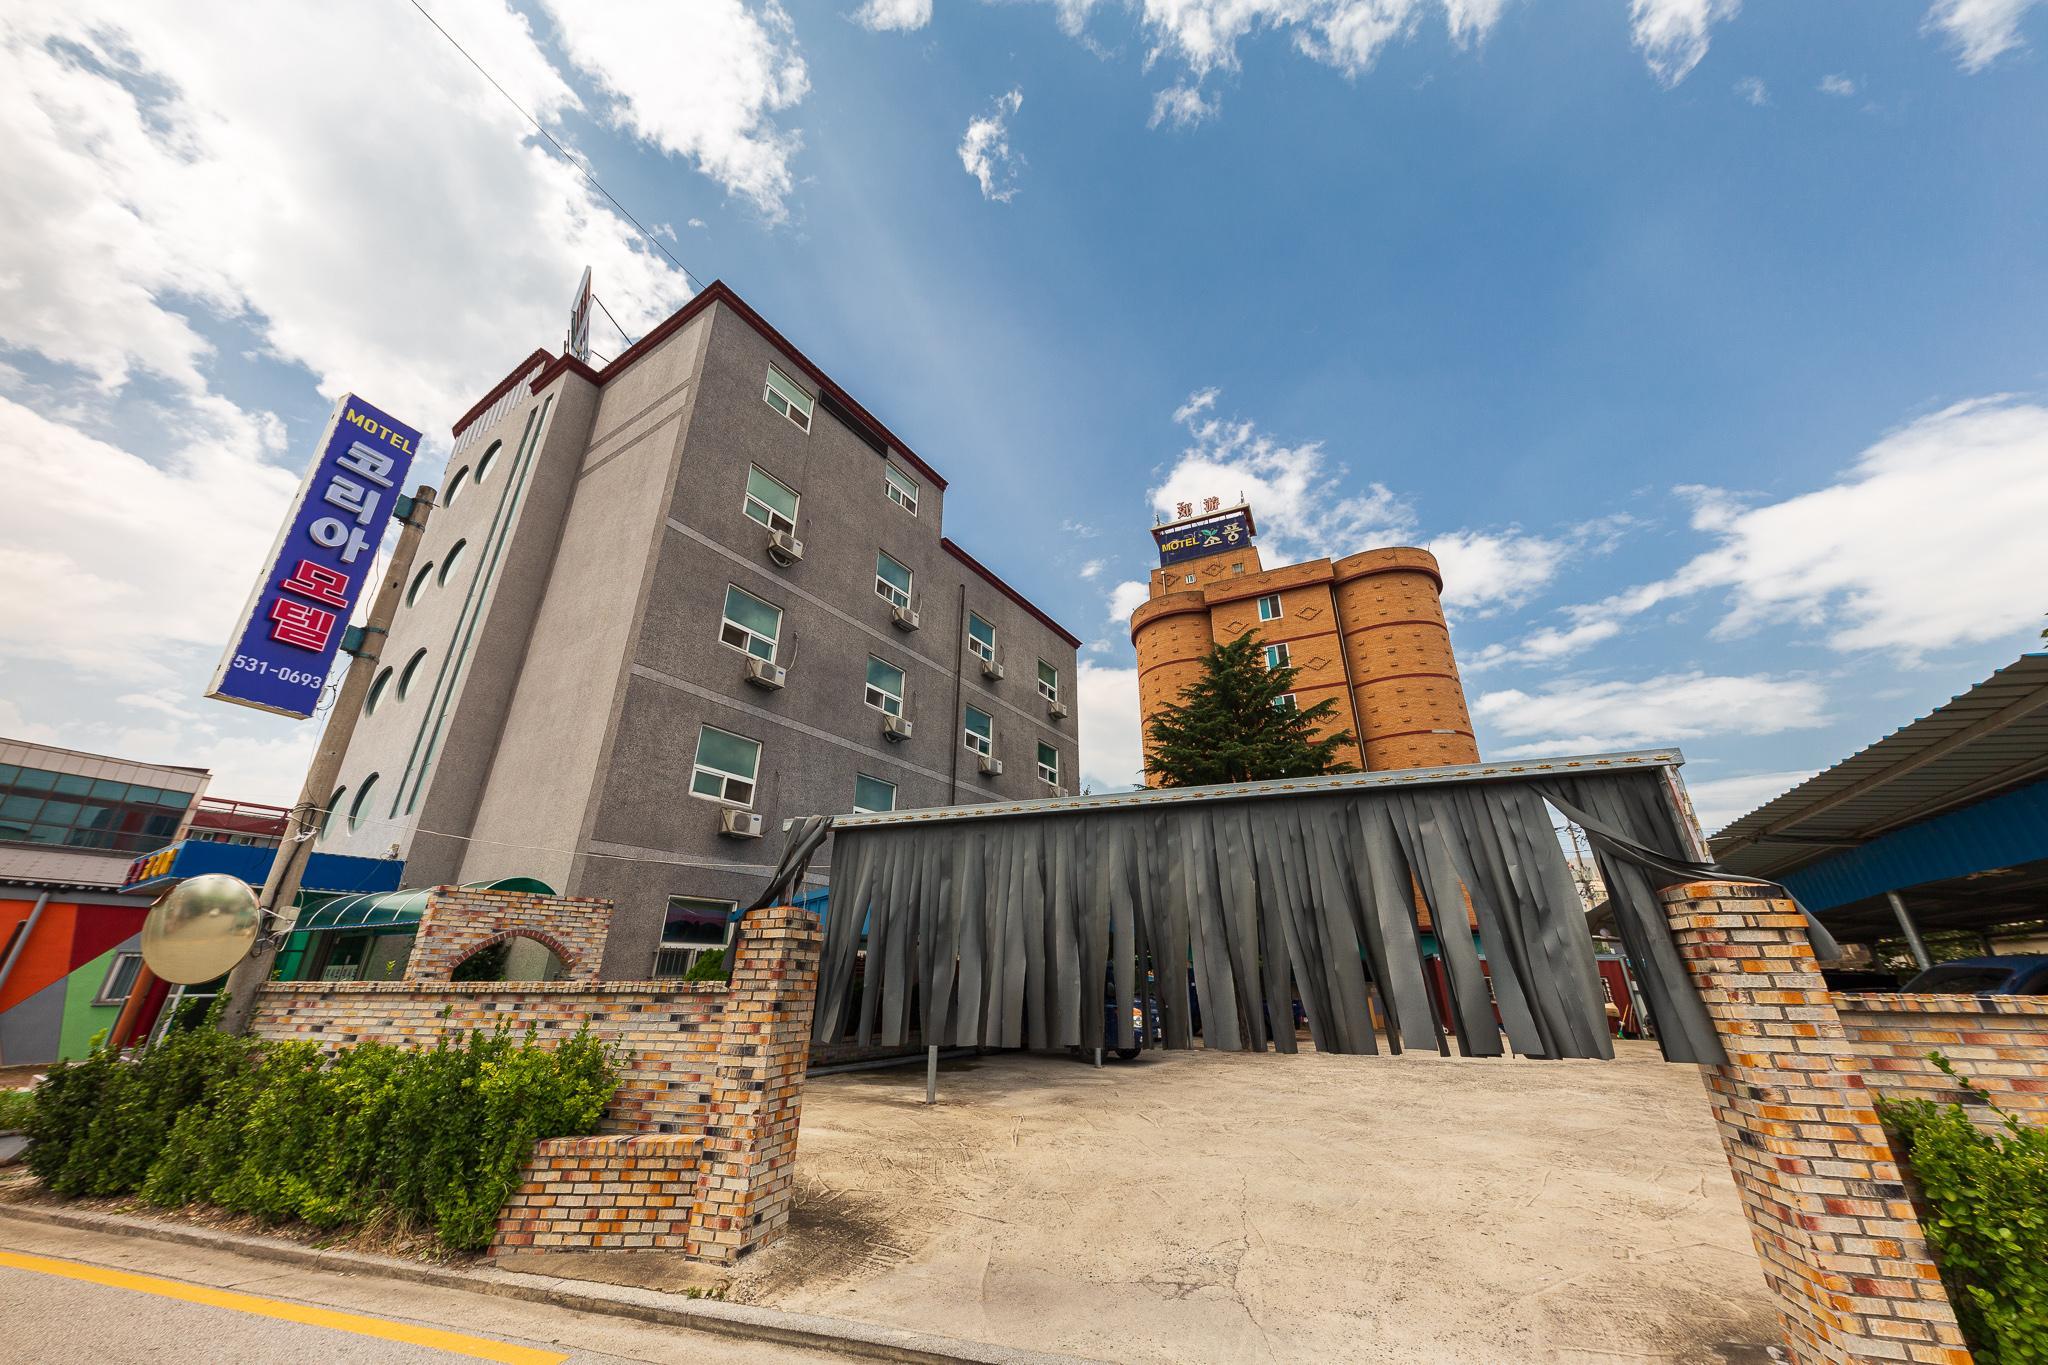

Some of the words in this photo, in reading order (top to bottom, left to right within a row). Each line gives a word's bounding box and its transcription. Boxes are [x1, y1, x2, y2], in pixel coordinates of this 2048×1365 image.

[346, 409, 412, 455] MOTEL
[308, 440, 394, 563] 코리아
[1161, 537, 1200, 553] MOTEL
[269, 559, 349, 652] 모텔
[233, 654, 322, 690] 531-0693
